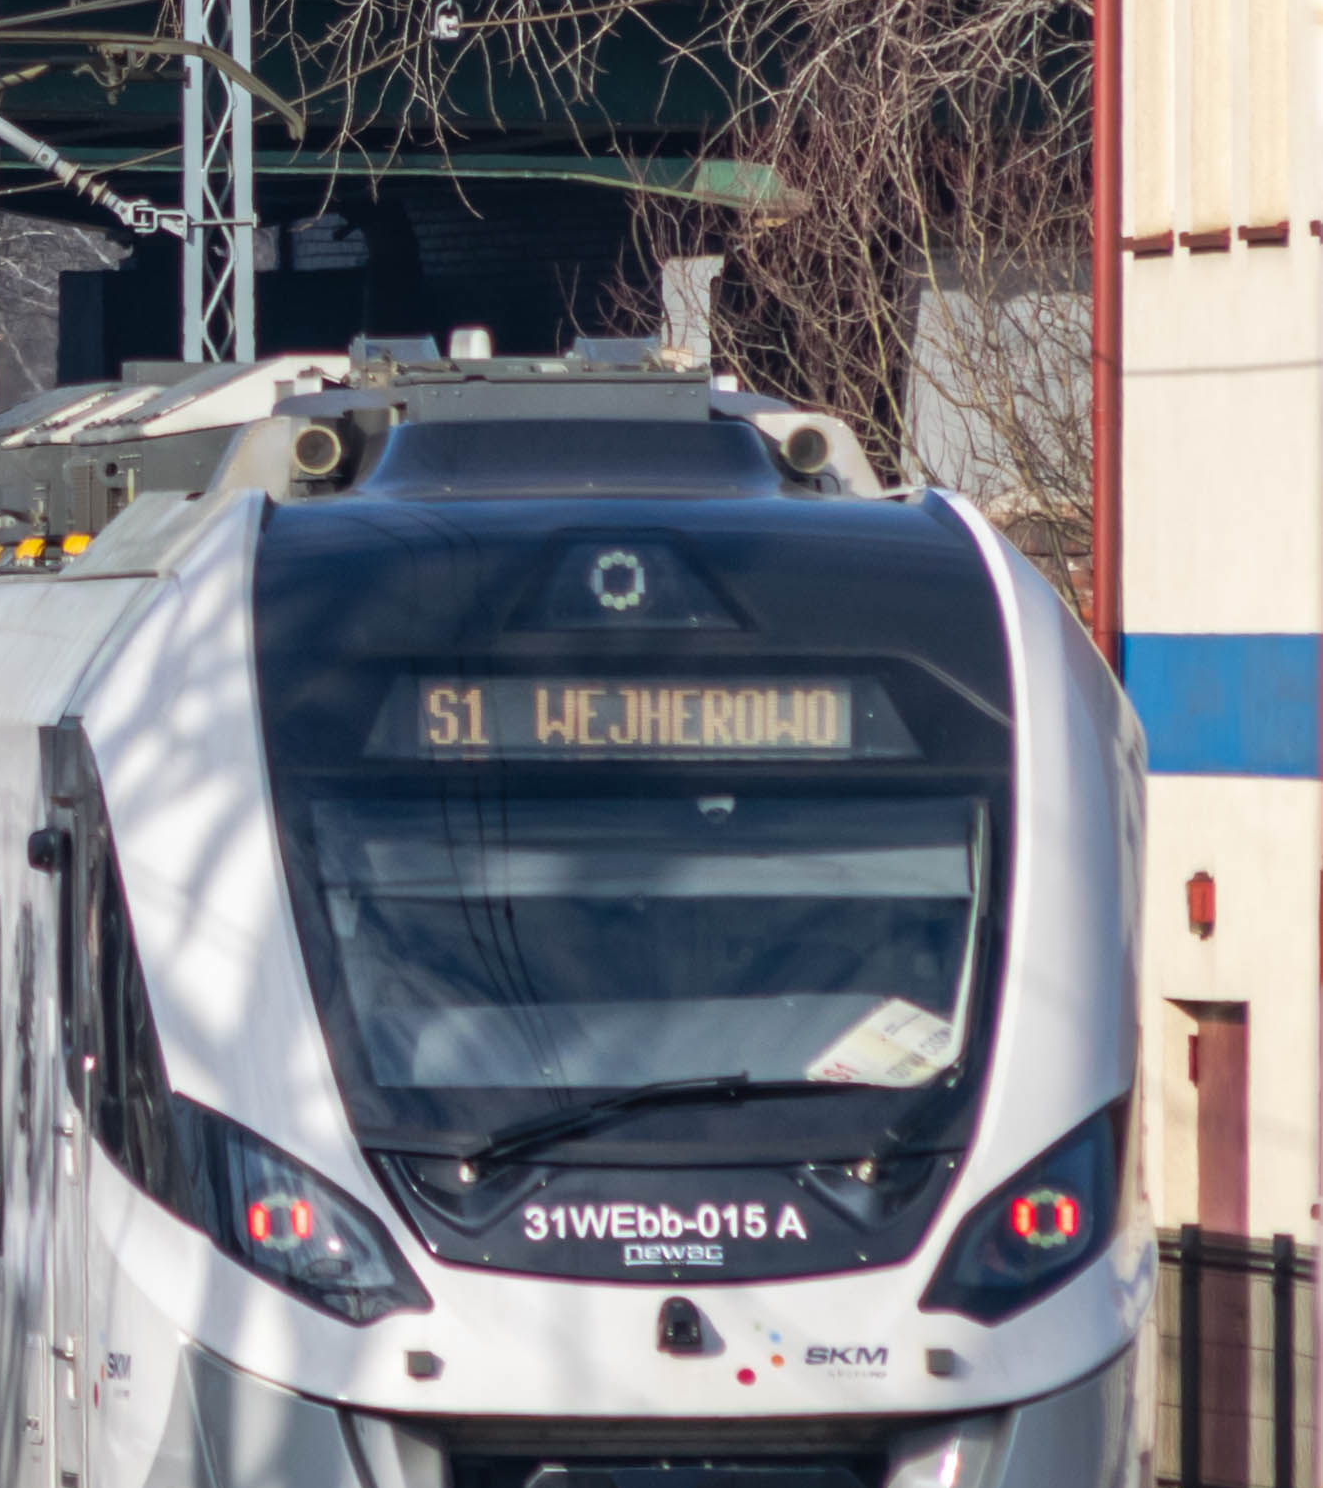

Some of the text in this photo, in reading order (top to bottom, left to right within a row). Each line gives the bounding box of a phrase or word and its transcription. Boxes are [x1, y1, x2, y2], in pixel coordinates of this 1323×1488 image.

[428, 688, 838, 746] S1 WEJHEROWO
[523, 1204, 808, 1241] 31WEbb-015 A
[804, 1346, 889, 1365] SKM
